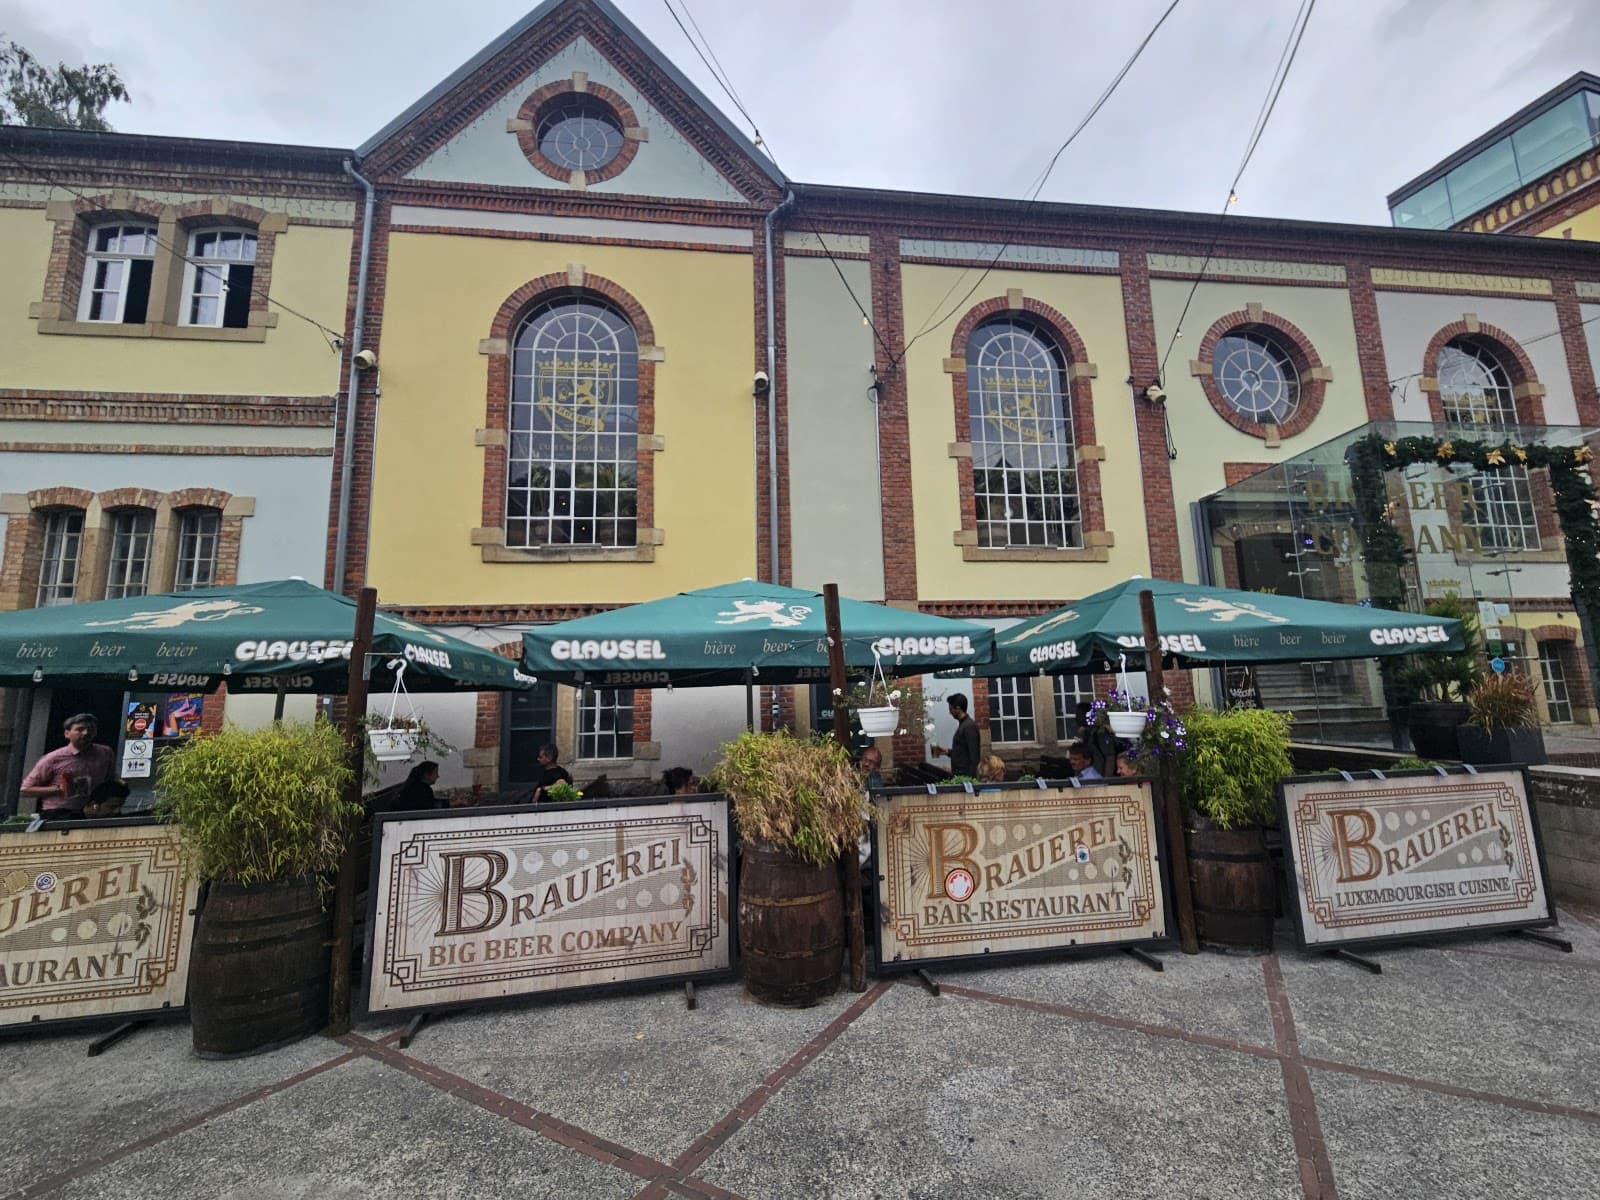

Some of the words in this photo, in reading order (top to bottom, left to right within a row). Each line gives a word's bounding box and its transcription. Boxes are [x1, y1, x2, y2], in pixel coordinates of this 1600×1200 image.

[16, 642, 59, 659] bière
[89, 640, 127, 657] beer
[156, 641, 198, 657] beier
[550, 639, 667, 660] CLAUSEL
[703, 640, 737, 655] bière
[762, 638, 792, 653] beer
[877, 636, 976, 656] CLAUSEL
[1029, 640, 1080, 664] CLAUSEL
[1233, 634, 1260, 649] bière
[1279, 632, 1301, 646] beer
[1321, 631, 1347, 645] beier
[1370, 626, 1450, 646] CLAUSEL
[922, 816, 1119, 901] BRAUEREI
[1326, 801, 1500, 884] BRAUEREI
[434, 838, 683, 938] BRAUEREI
[1336, 883, 1456, 908] LUXEMBOURGISH
[1458, 876, 1512, 898] CUISINE
[923, 890, 1125, 927] BAR-RESTAURANT
[428, 942, 477, 968] BIG
[484, 933, 554, 962] BEER
[560, 920, 684, 953] COMPANY
